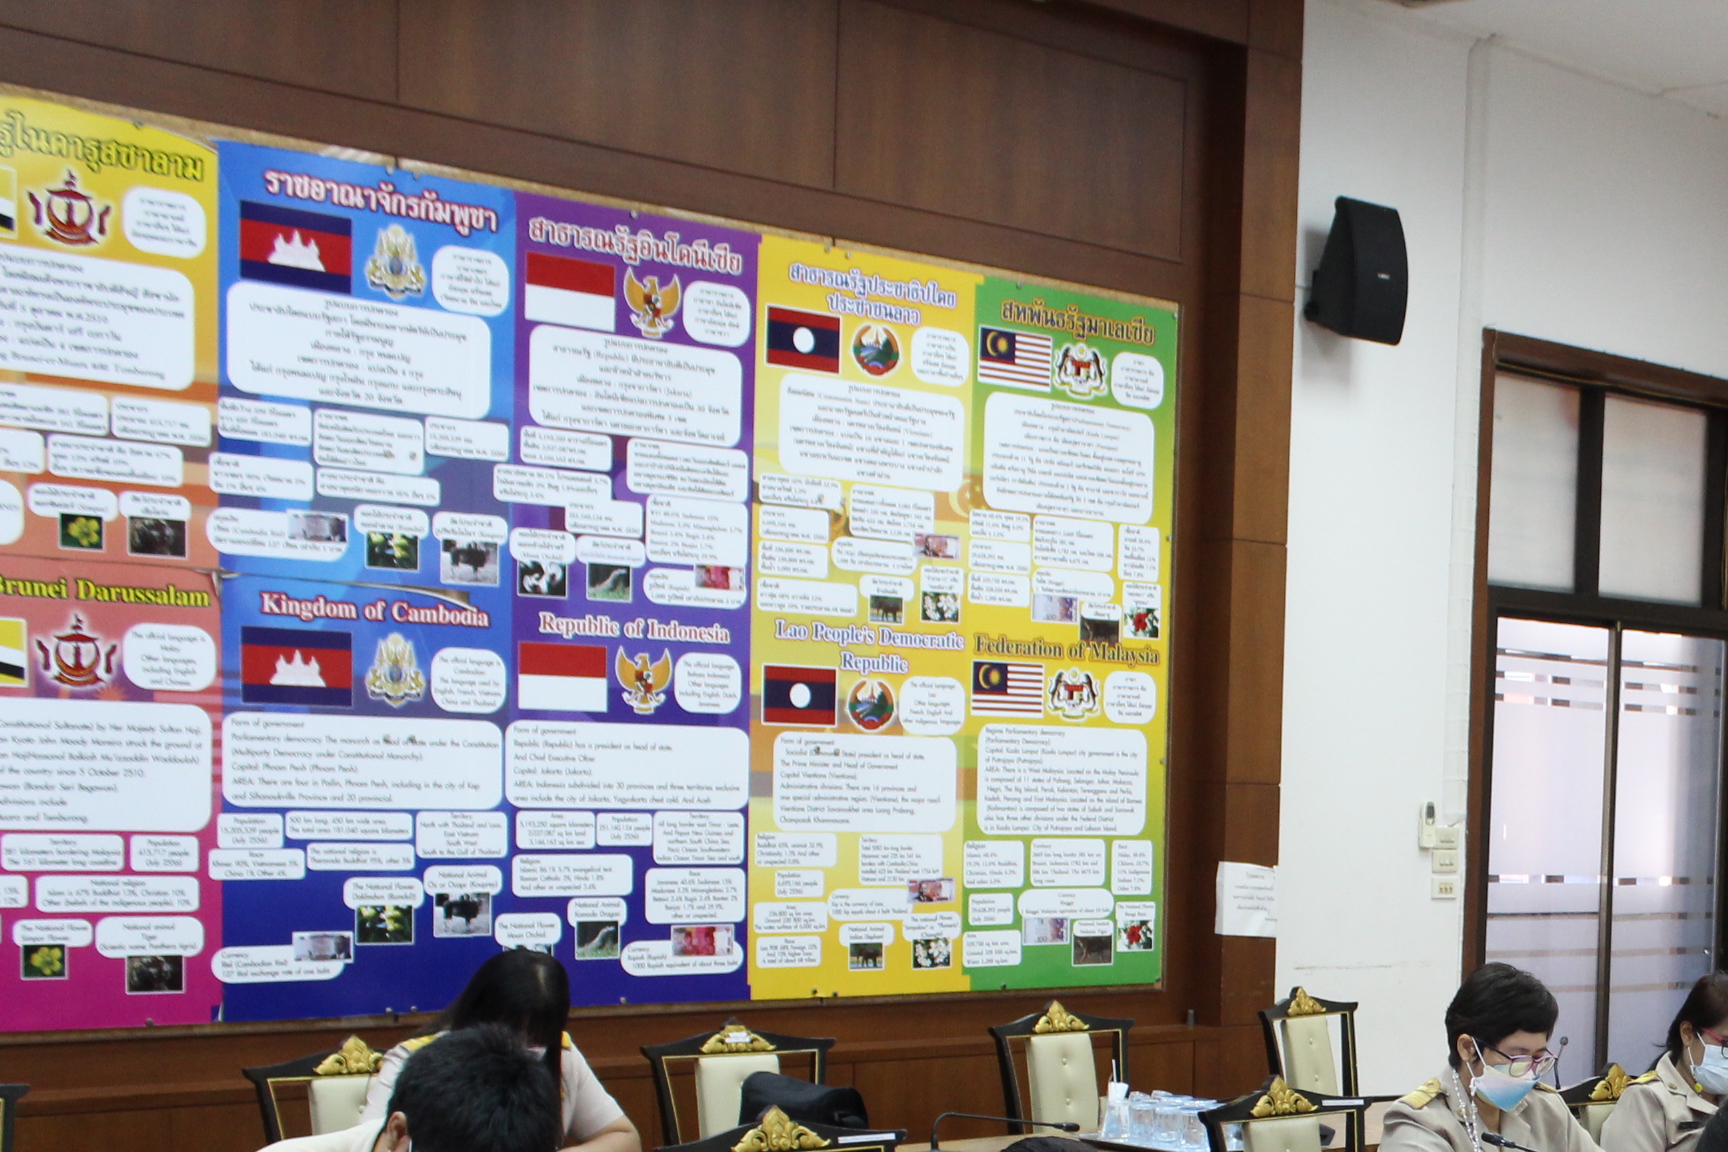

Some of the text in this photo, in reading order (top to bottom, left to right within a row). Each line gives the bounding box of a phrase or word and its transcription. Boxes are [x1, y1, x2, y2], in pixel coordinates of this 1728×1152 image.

[263, 169, 499, 237] ราชอาณาจักรกัมพูชา
[529, 216, 743, 276] สาธารณรัฐอินโดนีเซีย
[789, 262, 957, 308] สาธารณรัฐประชาธิปไตย
[826, 292, 922, 326] ประชาชนลาว
[1001, 297, 1156, 345] สหพันธรัฐมาเลเซีย
[75, 578, 209, 607] Darussalam
[260, 590, 490, 628] Kingdom of Cambodia
[538, 611, 731, 644] Republic of Indonesia
[774, 619, 965, 650] Lao People's Democratic
[840, 651, 909, 675] Republic
[973, 633, 1161, 668] Federation of Malaysia
